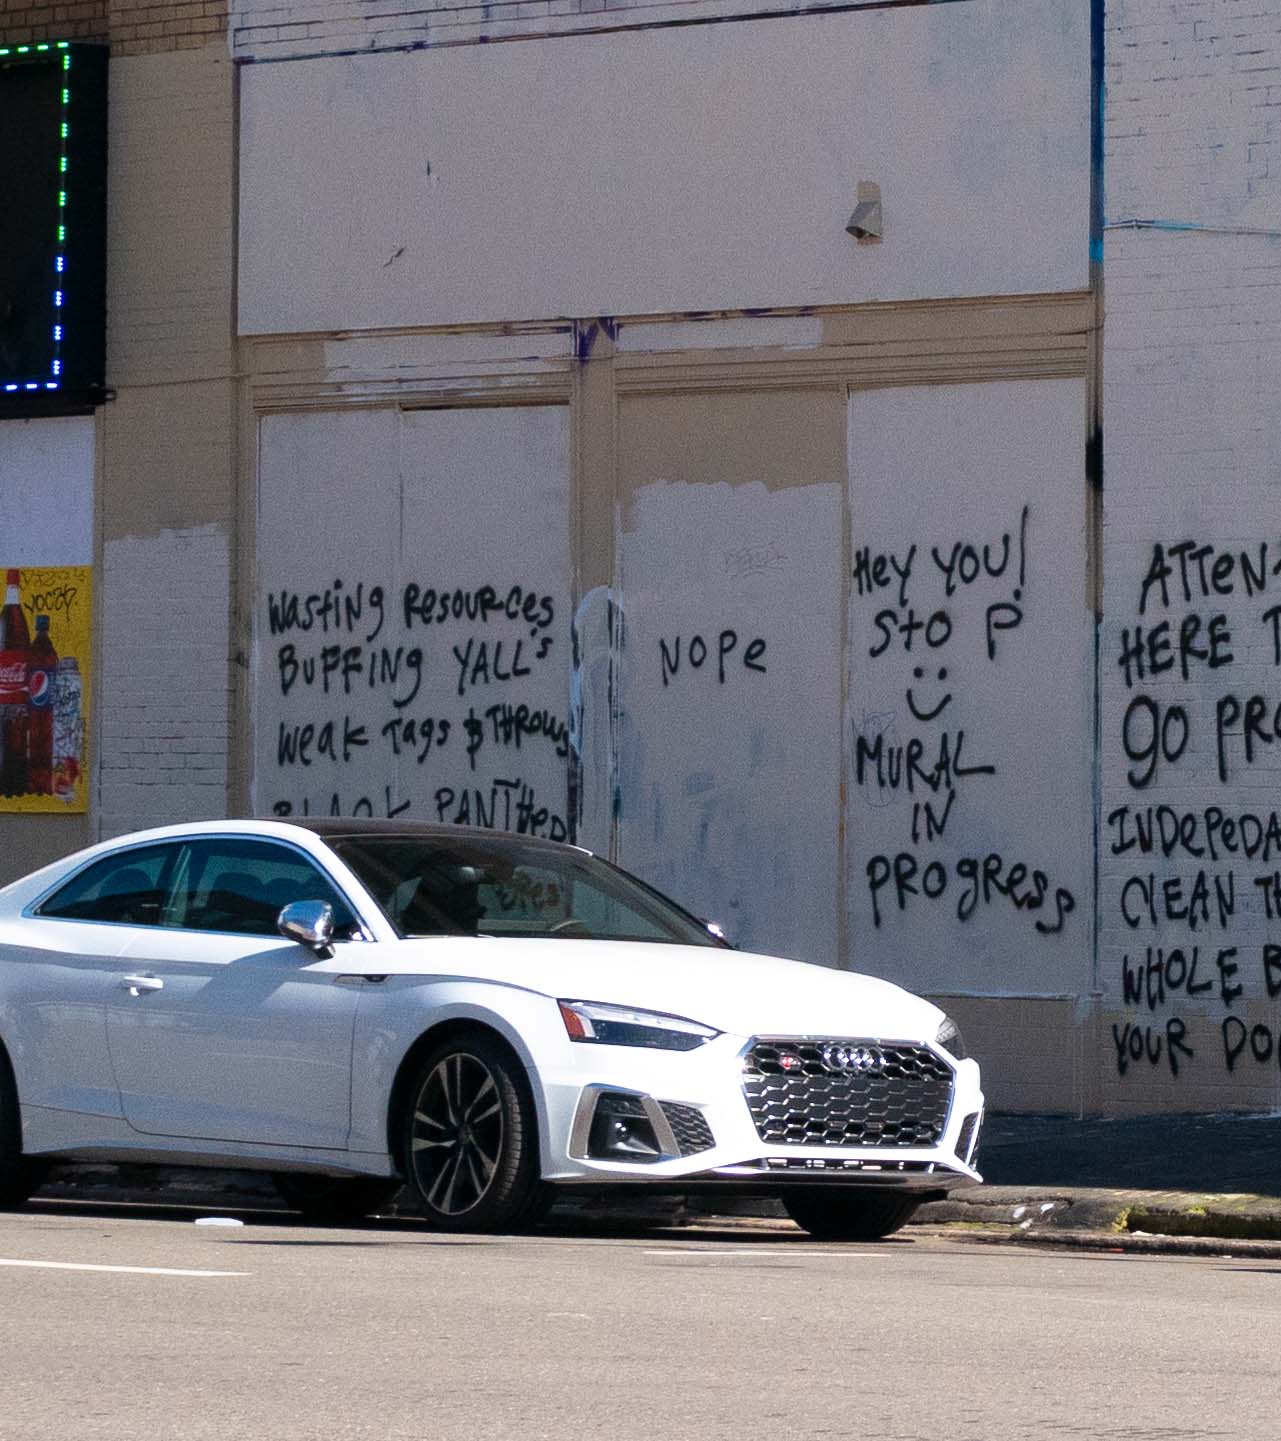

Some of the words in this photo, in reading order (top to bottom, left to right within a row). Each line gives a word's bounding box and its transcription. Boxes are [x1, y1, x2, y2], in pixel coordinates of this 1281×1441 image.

[931, 504, 1029, 600] YOU!
[1118, 614, 1234, 688] HERE
[854, 730, 996, 793] MURAL
[911, 788, 956, 844] IN
[1121, 944, 1243, 1012] WHOLE
[1111, 1016, 1195, 1077] YOUR
